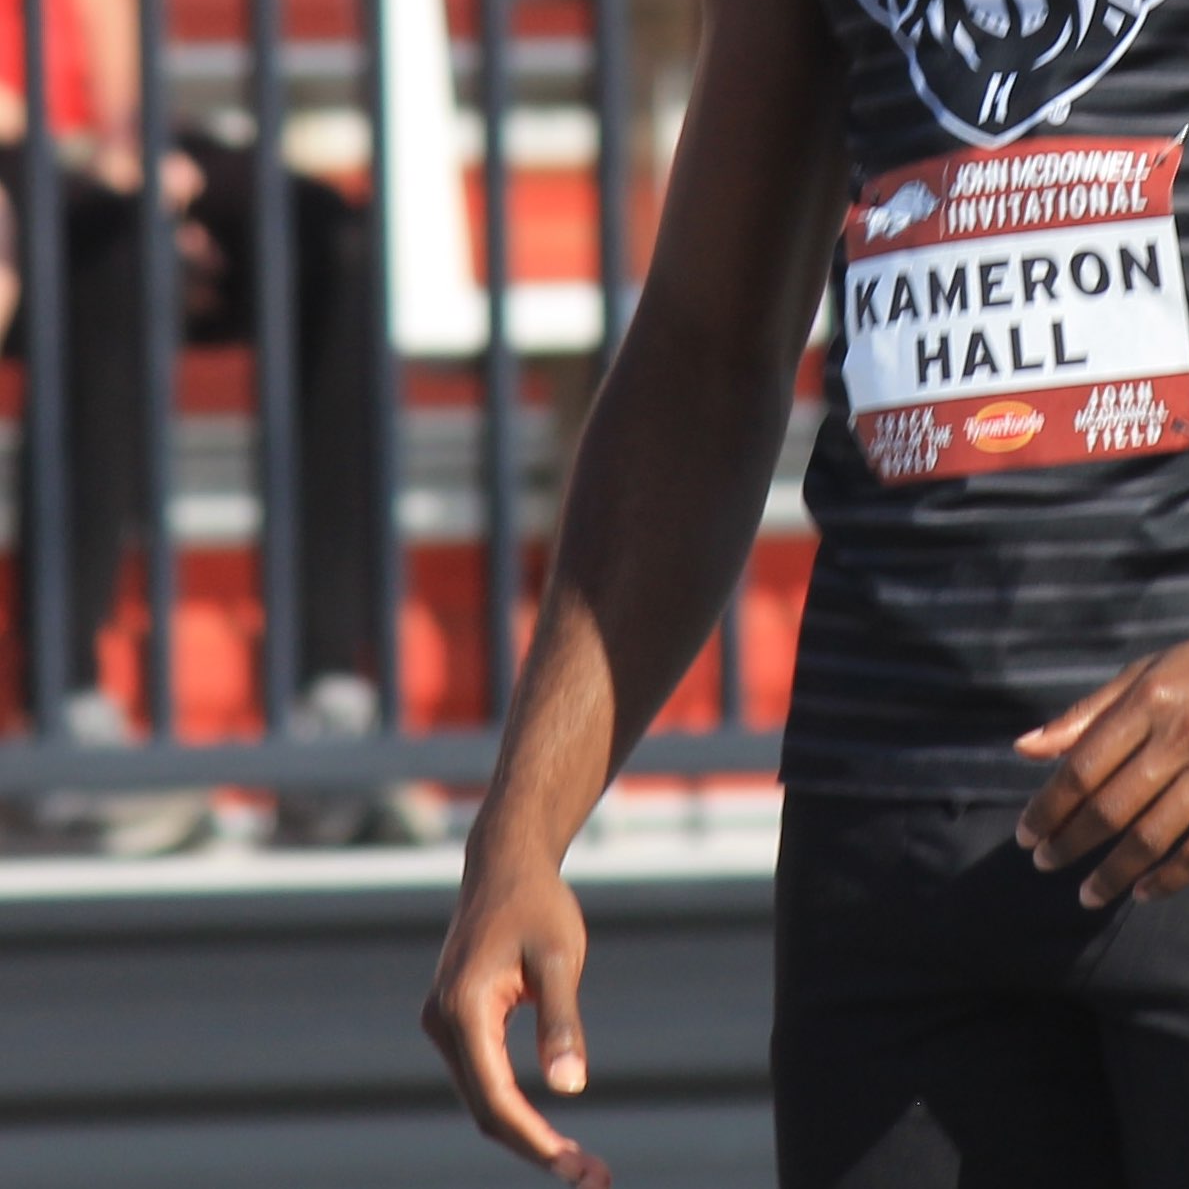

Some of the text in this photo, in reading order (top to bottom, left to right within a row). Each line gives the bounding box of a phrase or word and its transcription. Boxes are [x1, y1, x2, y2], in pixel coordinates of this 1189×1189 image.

[949, 150, 1151, 198] JOHN MCDONNELL
[948, 181, 1148, 234] INVITATIONAL
[855, 243, 1162, 330] KAMERON
[916, 319, 1089, 386] HALL
